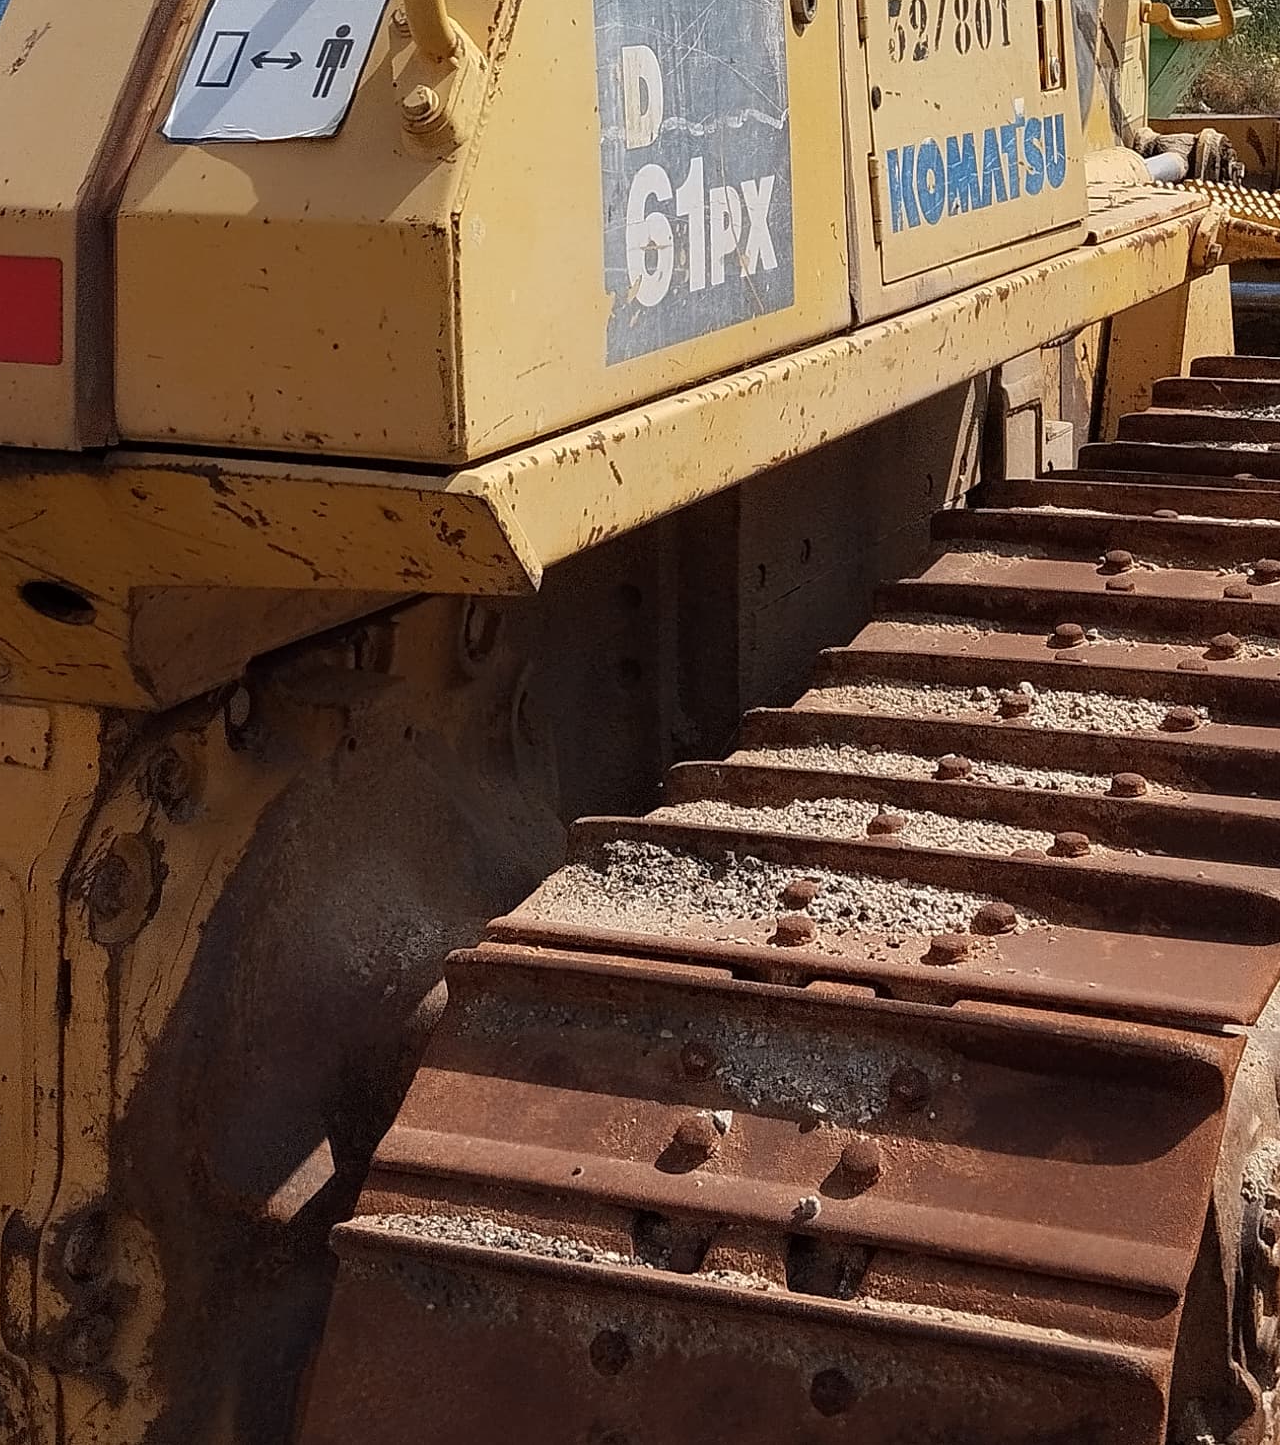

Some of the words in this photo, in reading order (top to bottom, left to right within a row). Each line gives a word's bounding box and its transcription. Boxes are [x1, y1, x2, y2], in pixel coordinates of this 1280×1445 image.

[621, 44, 664, 150] D
[886, 97, 1067, 234] KOMATSU
[625, 155, 779, 307] 61PX
